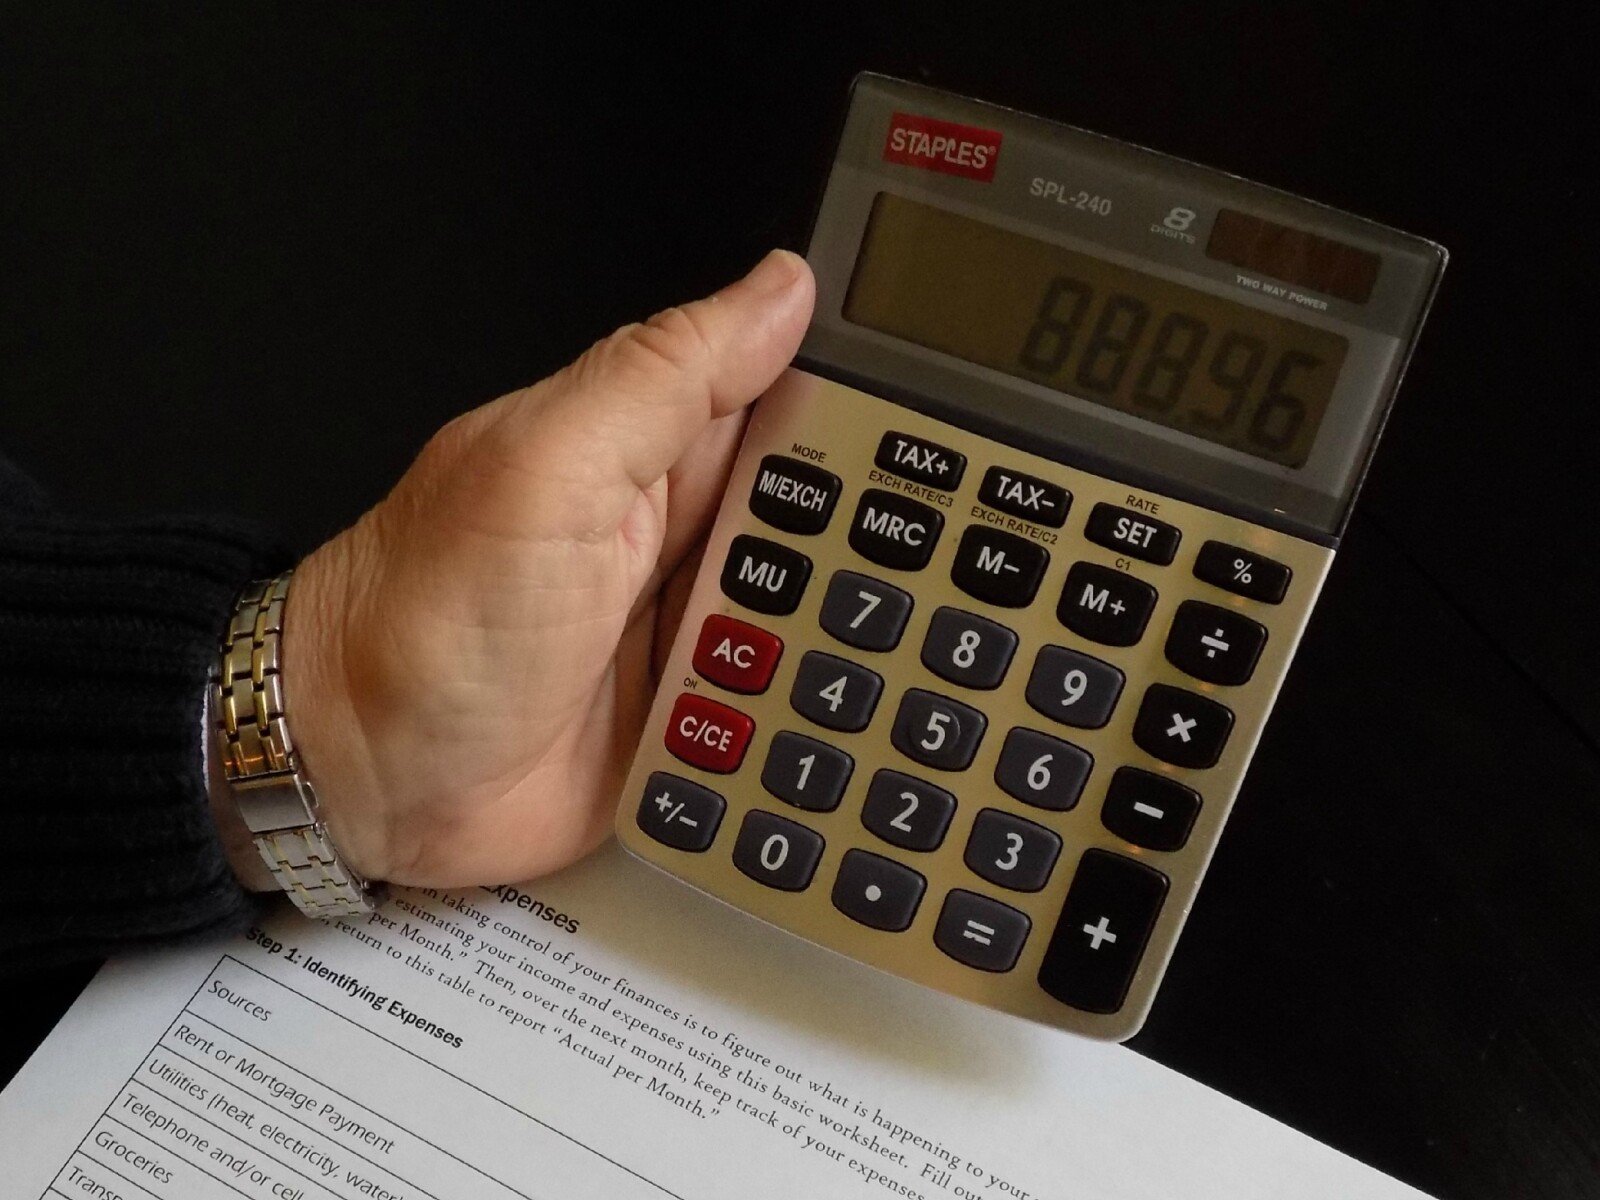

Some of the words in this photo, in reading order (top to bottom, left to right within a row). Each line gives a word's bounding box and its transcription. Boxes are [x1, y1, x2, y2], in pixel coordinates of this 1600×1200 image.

[1029, 177, 1112, 217] SPL-240
[1150, 224, 1196, 245] DIGITS
[1163, 206, 1196, 231] 8
[1236, 274, 1260, 289] TWO
[1262, 283, 1287, 298] WAY
[1288, 291, 1328, 311] POWER
[791, 442, 827, 463] MODE
[894, 440, 949, 475] TAX+
[758, 470, 828, 512] M/EXCH
[868, 470, 902, 490] EXCH
[902, 482, 954, 508] RATE/C3
[998, 475, 1055, 511] TAX-
[1126, 494, 1160, 515] RATE
[862, 507, 926, 547] MRC
[970, 505, 1005, 526] EXCH
[1006, 517, 1059, 546] RATE/C2
[1113, 516, 1158, 548] SET
[738, 555, 788, 593] MU
[1115, 557, 1131, 571] C1
[1233, 558, 1252, 584] %
[850, 590, 882, 629] 7
[1079, 582, 1126, 616] M+
[711, 637, 756, 669] AC
[952, 629, 981, 669] 8
[683, 677, 698, 690] ON
[818, 675, 848, 713] 4
[1061, 669, 1087, 706] 9
[679, 715, 734, 753] C/CE
[920, 710, 950, 751] 5
[798, 754, 815, 791] 1
[1026, 754, 1054, 791] 6
[889, 791, 919, 833] 2
[760, 832, 790, 873] 0
[995, 832, 1024, 871] 3
[479, 884, 580, 934] xpenses
[208, 980, 272, 1021] Sources
[245, 927, 282, 955] Step
[284, 948, 302, 964] 1:
[302, 956, 388, 1011] Identifying
[387, 1000, 464, 1049] Expenses
[335, 918, 382, 950] return
[386, 944, 402, 959] to
[405, 954, 435, 977] this
[437, 972, 475, 998] table
[479, 993, 495, 1007] to
[496, 1003, 547, 1035] report
[612, 1062, 645, 1083] per
[368, 912, 397, 930] per
[474, 960, 516, 995] Then,
[522, 989, 559, 1013] over
[562, 1005, 587, 1029] the
[590, 1023, 628, 1049] next
[630, 1042, 688, 1083] month,
[694, 1072, 732, 1105] keep
[736, 1096, 779, 1128] track
[783, 1122, 806, 1139] of
[801, 1135, 845, 1162] your
[848, 1154, 925, 1200] expenses
[396, 899, 475, 947] estimating
[475, 940, 516, 964] your
[517, 957, 576, 995] income
[579, 988, 612, 1012] and
[612, 1006, 684, 1050] expenses
[688, 1046, 732, 1079] using
[737, 1069, 768, 1093] this
[772, 1084, 814, 1118] basic
[818, 1111, 908, 1169] worksheet.
[920, 1163, 952, 1189] Fill
[441, 892, 490, 928] taking
[494, 921, 552, 955] control
[552, 951, 575, 966] of
[569, 960, 611, 986] your
[612, 977, 688, 1021] finances
[684, 1012, 698, 1031] is
[702, 1025, 718, 1041] to
[721, 1033, 771, 1068] figure
[775, 1064, 803, 1085] out
[808, 1080, 850, 1109] what
[854, 1101, 868, 1118] is
[872, 1109, 962, 1170] happening
[966, 1162, 984, 1177] to
[984, 1174, 1031, 1200] your
[174, 1024, 214, 1054] Rent
[215, 1049, 235, 1065] or
[234, 1058, 317, 1110] Mortgage
[318, 1104, 395, 1154] Payment
[149, 1059, 208, 1101] Utilities
[206, 1093, 255, 1130] (heat,
[259, 1124, 340, 1178] electricity,
[95, 1130, 173, 1184] Groceries
[122, 1093, 210, 1152] Telephone
[210, 1147, 271, 1187] and/or
